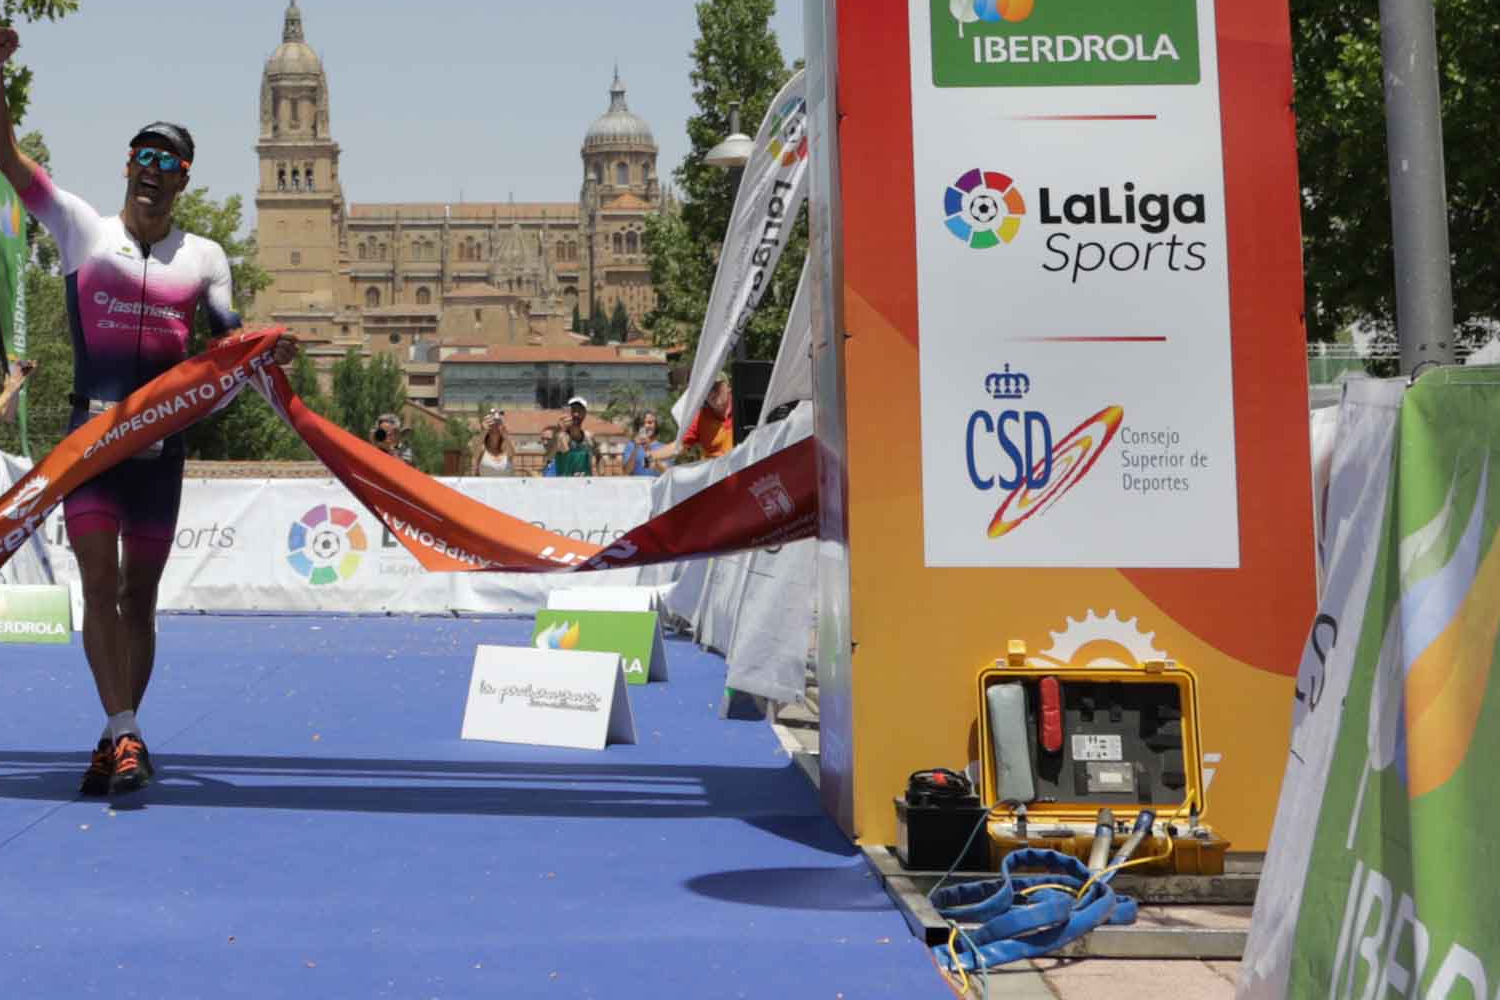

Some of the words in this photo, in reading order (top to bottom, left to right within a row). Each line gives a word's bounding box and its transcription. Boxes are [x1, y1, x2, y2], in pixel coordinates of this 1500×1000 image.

[972, 33, 1180, 64] IBERDROLA
[1039, 181, 1206, 234] LaLiga
[1041, 232, 1207, 284] Sports
[83, 383, 215, 460] CAMPEONATO
[219, 365, 246, 392] DE
[965, 409, 1053, 491] CSD
[1120, 426, 1180, 450] Consejo
[1121, 449, 1185, 472] Superior
[1190, 448, 1210, 468] de
[1122, 473, 1190, 496] Deportes
[175, 521, 237, 550] orts
